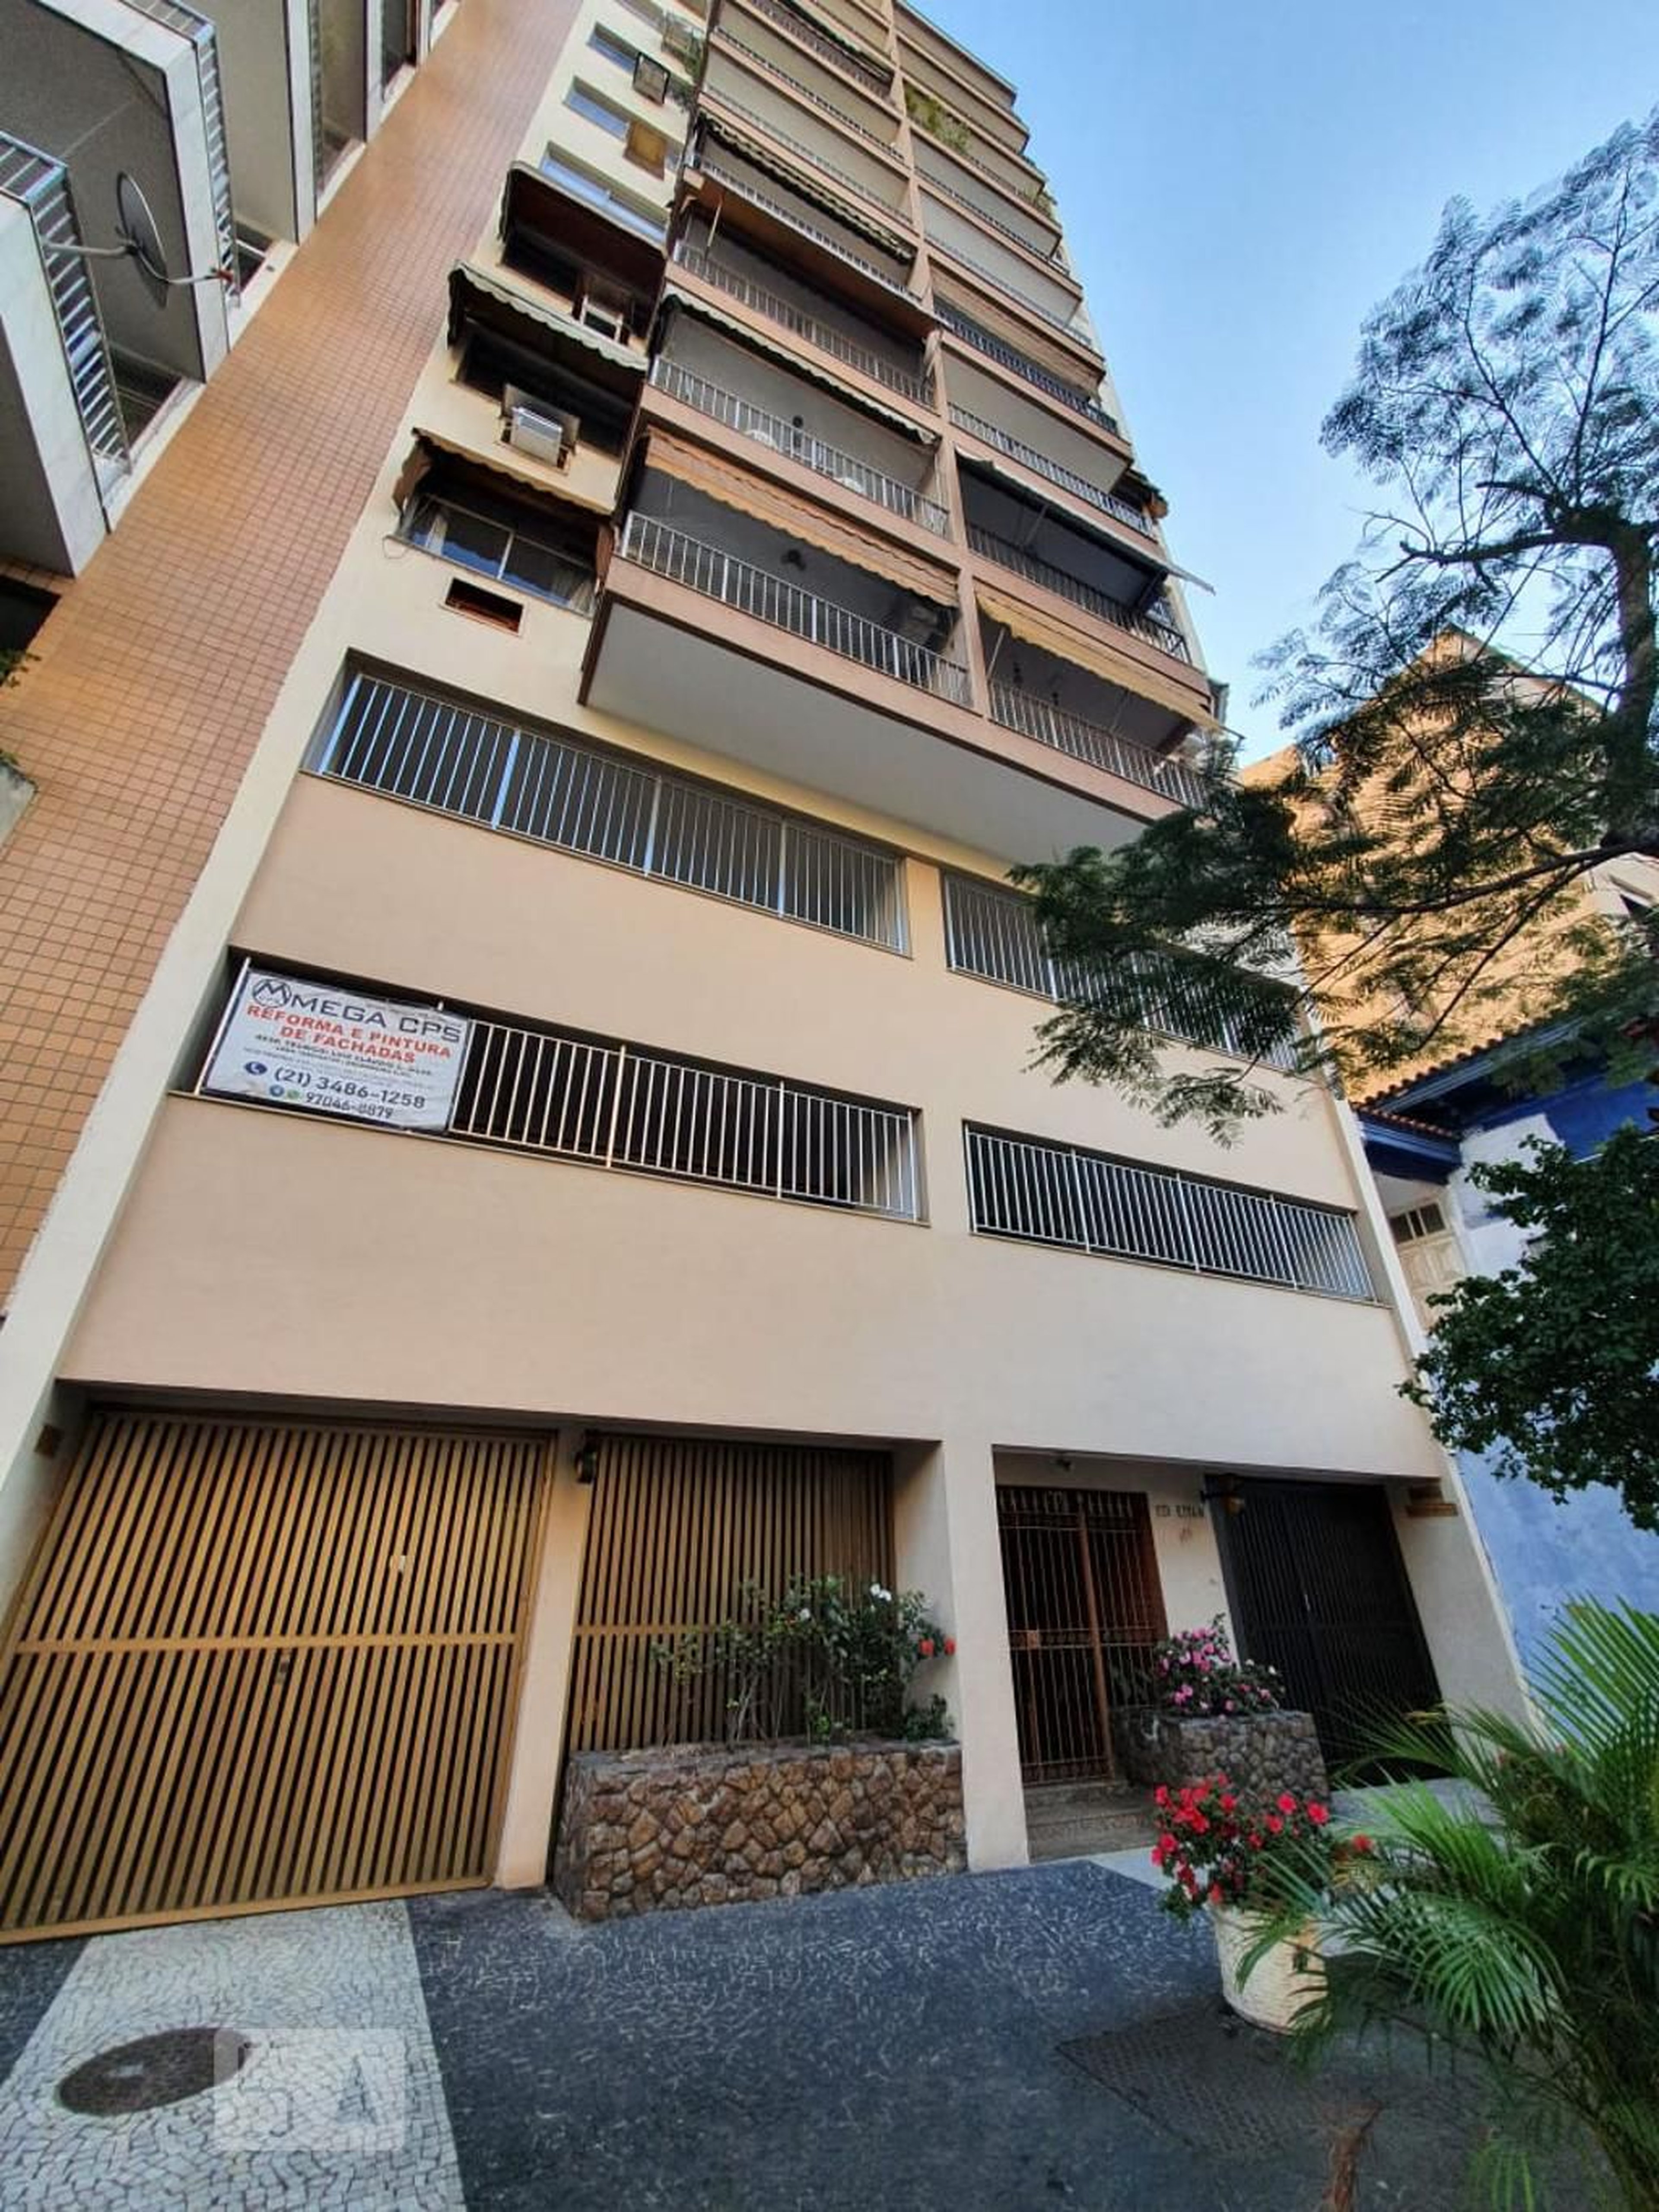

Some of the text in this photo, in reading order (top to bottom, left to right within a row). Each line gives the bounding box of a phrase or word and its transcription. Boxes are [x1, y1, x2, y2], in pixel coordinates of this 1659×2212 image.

[247, 1006, 451, 1058] REFORMA E PINTURA
[291, 994, 387, 1028] MEGA
[399, 1017, 461, 1043] CPS
[280, 1026, 301, 1040] DE
[315, 1033, 415, 1063] FACHADAS
[273, 1067, 311, 1088] (21)
[316, 1077, 426, 1109] 3486-1258
